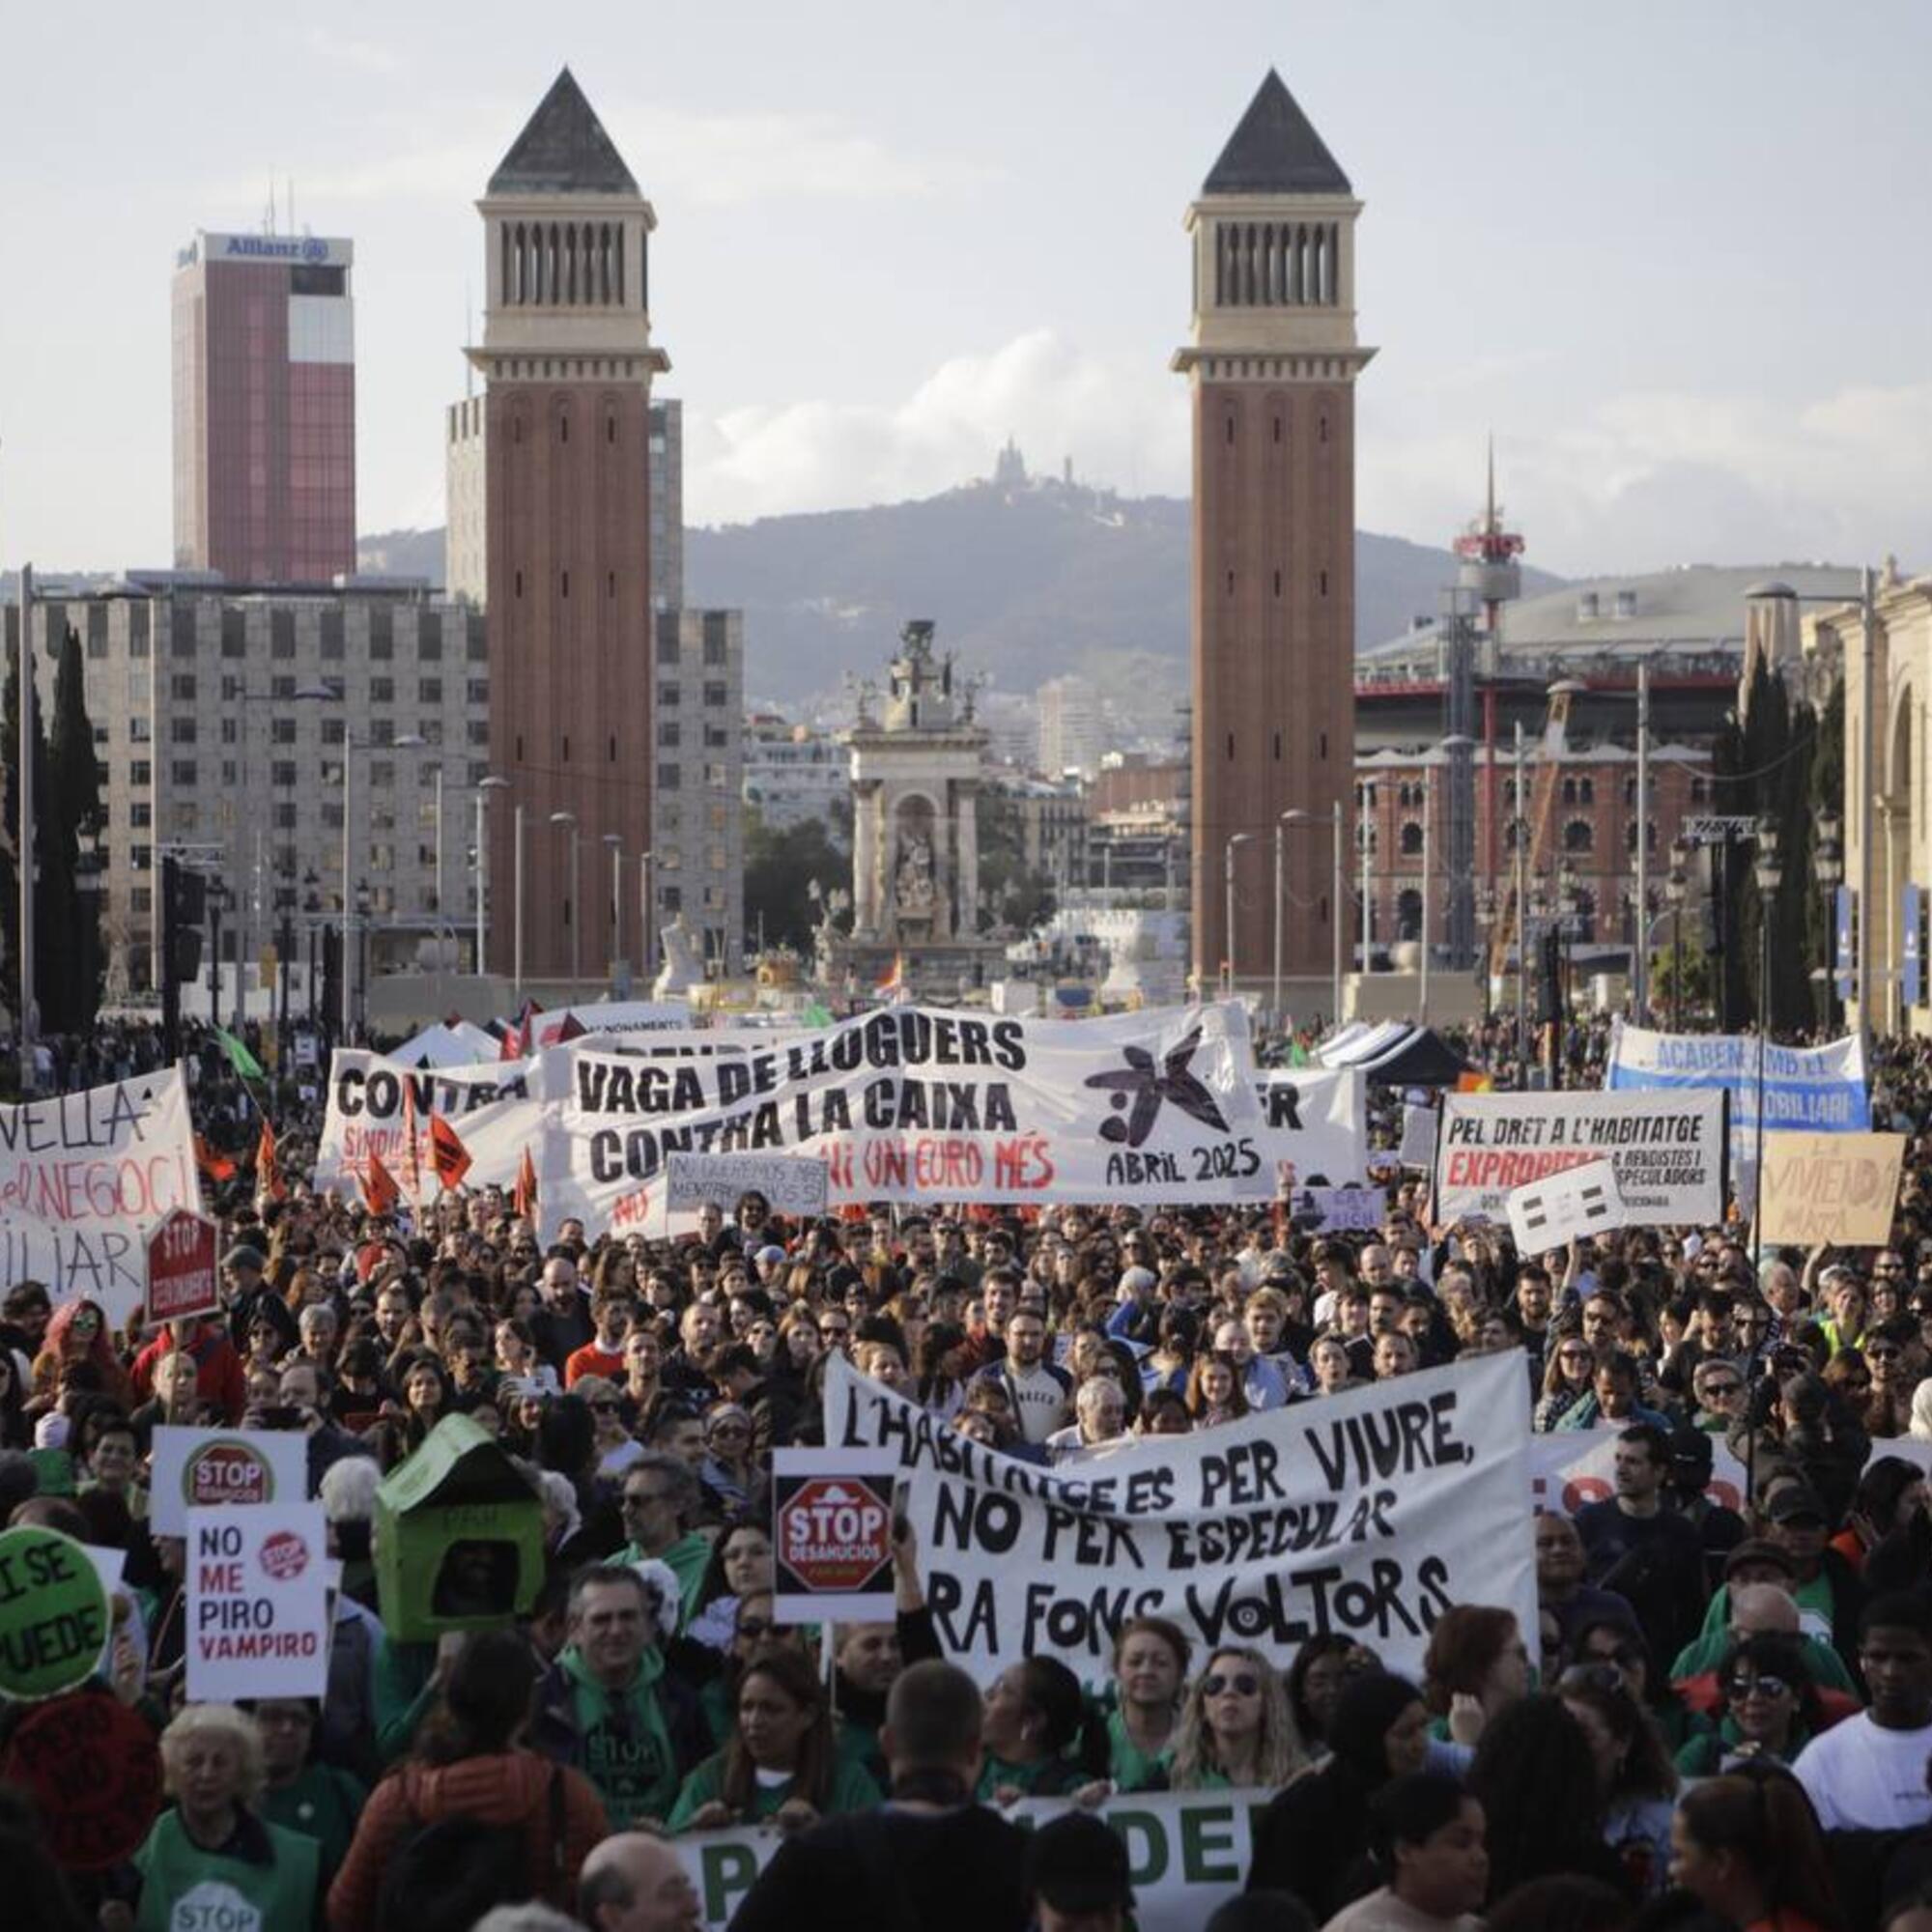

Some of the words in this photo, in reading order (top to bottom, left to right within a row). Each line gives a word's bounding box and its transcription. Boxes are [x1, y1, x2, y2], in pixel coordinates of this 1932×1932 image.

[227, 239, 298, 255] Allianz
[579, 1062, 706, 1114] VAGA
[717, 1054, 777, 1108] DE
[787, 1013, 1027, 1080] LLOGUERS
[0, 1082, 151, 1153] VELLA
[590, 1101, 784, 1184] CONTRA
[796, 1088, 852, 1138] LA
[865, 1077, 1017, 1133] CAIXA
[1447, 1118, 1485, 1145] PEL
[1492, 1118, 1548, 1146] DRET
[1549, 1117, 1566, 1145] A
[1573, 1115, 1704, 1146] L'HABITATGE
[865, 1137, 908, 1189] UN
[916, 1137, 984, 1189] EURO
[995, 1130, 1056, 1190] MÉS
[1192, 1138, 1261, 1181] 2025
[1616, 1168, 1706, 1186] SPECULADORS
[1199, 1437, 1288, 1511] PER
[1303, 1390, 1478, 1492] VIURE,
[196, 1461, 261, 1487] STOP
[199, 1526, 242, 1558] NO
[788, 1505, 883, 1544] STOP
[932, 1480, 1023, 1555] NO
[1041, 1501, 1146, 1571] PER
[24, 1539, 76, 1588] SE
[199, 1563, 244, 1594] ME
[199, 1598, 274, 1631] PIRO
[1186, 1555, 1451, 1649] VOLTORS
[0, 1605, 99, 1676] UEDE
[199, 1632, 317, 1662] VAMPIRO
[177, 1906, 255, 1930] STOP
